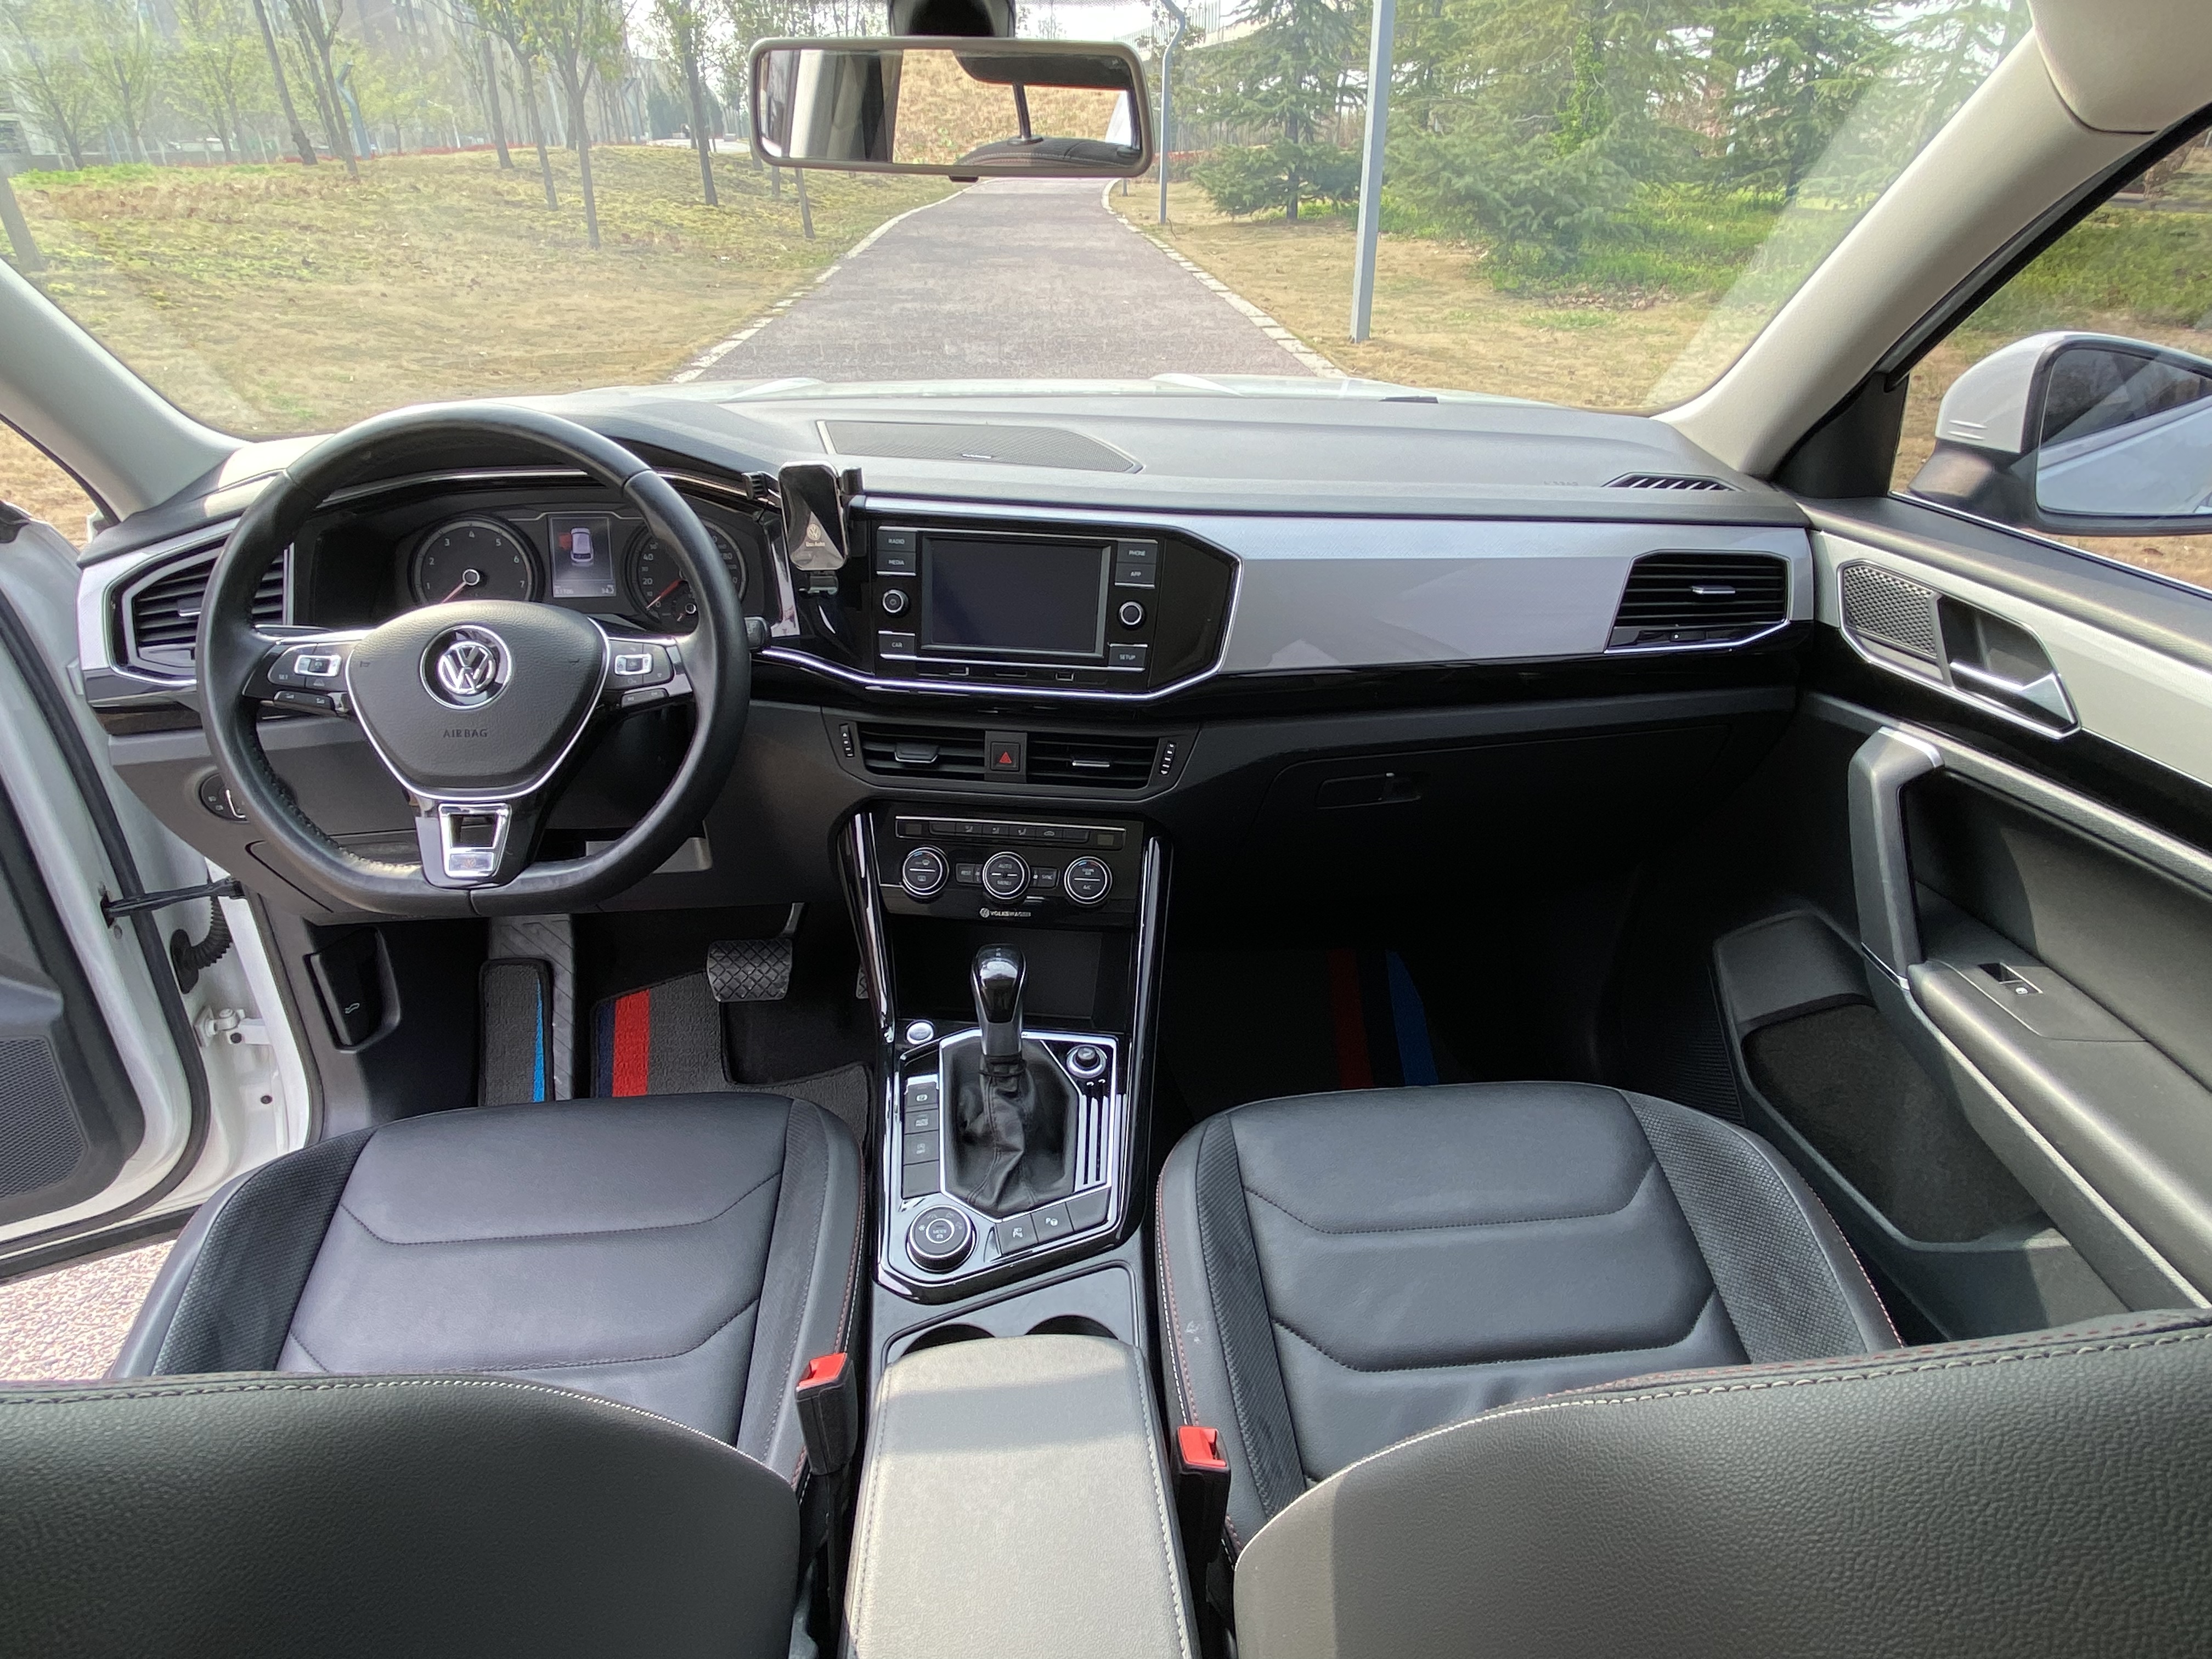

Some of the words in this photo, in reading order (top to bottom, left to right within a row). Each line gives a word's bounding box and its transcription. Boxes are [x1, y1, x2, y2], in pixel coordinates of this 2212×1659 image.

[444, 538, 450, 546] 3
[495, 538, 501, 546] 5
[429, 557, 435, 566] 2
[513, 555, 520, 564] 6
[520, 580, 525, 588] 7
[438, 640, 496, 695] VW
[443, 729, 488, 738] AIRBAG
